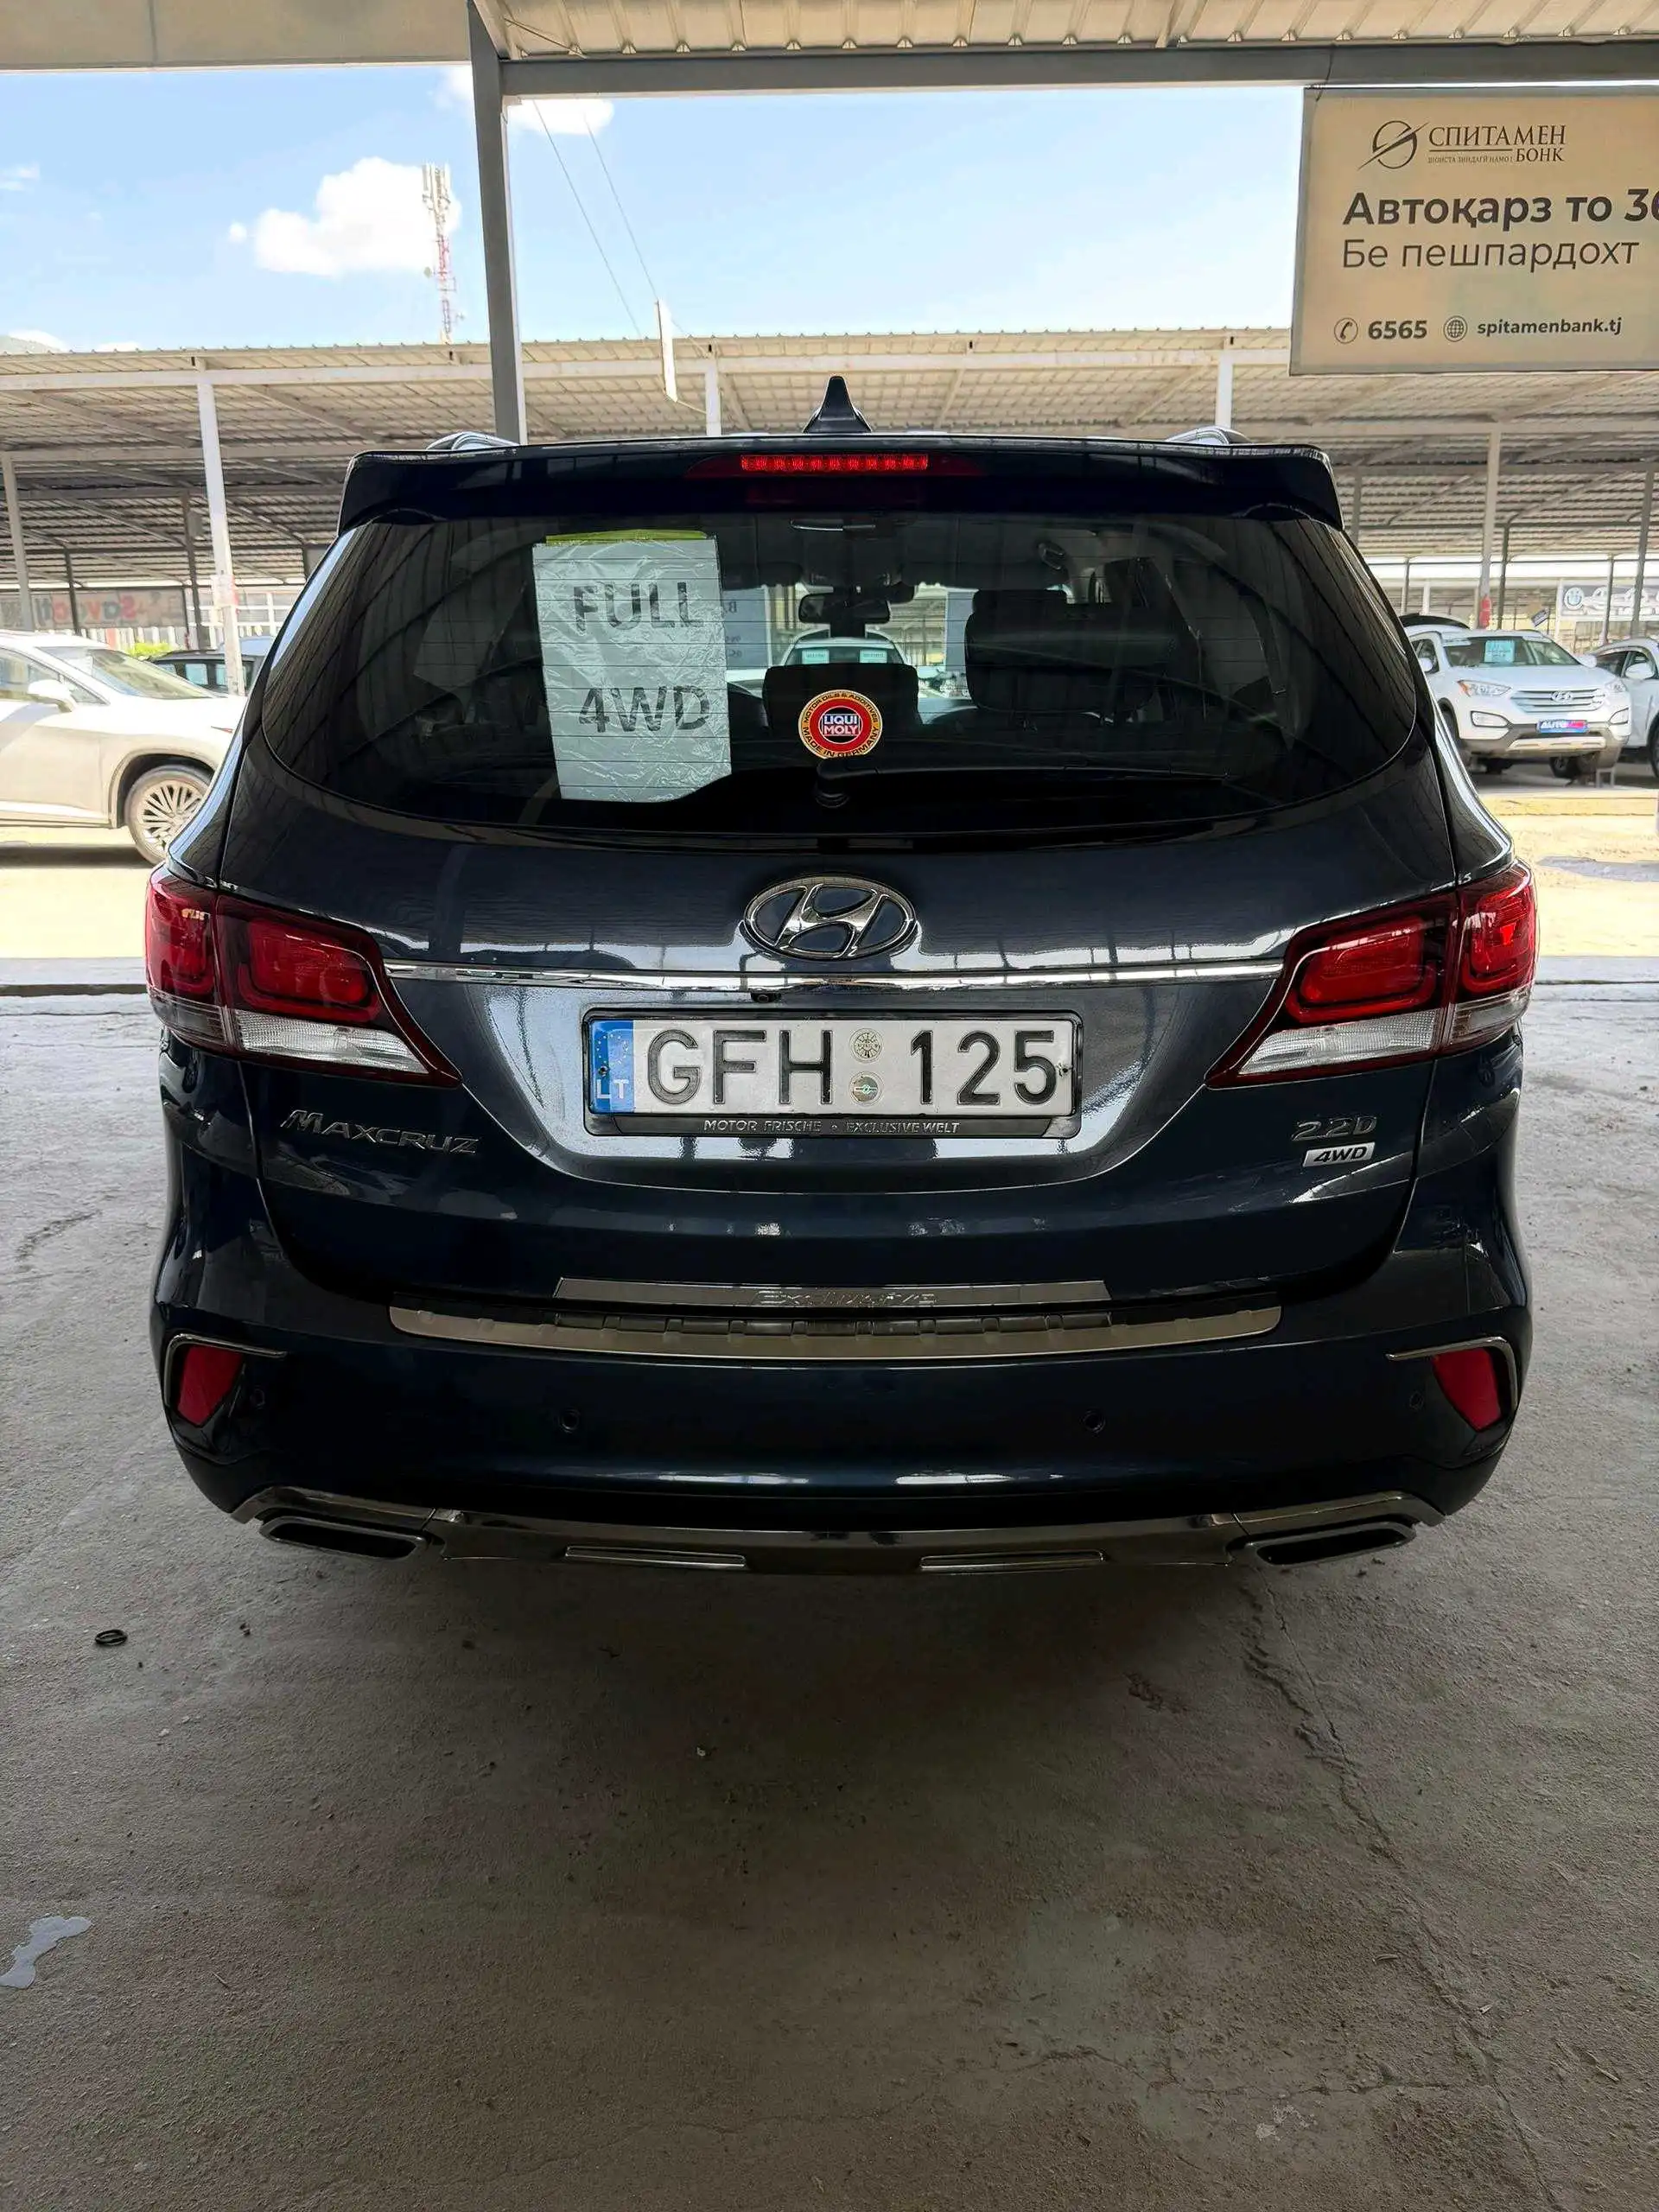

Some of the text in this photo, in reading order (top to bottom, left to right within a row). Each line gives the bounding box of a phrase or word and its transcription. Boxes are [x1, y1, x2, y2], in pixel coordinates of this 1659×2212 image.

[1428, 124, 1567, 147] СПИТАМЕН
[1516, 147, 1565, 162] БОНК
[1342, 192, 1552, 232] Автоқарз
[1566, 195, 1613, 222] то
[1343, 238, 1639, 273] Бе пешпардохт
[1368, 320, 1427, 340] 6565
[1477, 316, 1623, 337] spitamenbank.tj
[574, 582, 704, 632] FULL
[578, 684, 710, 734] 4WD
[823, 715, 858, 725] LIQUI
[823, 725, 858, 734] MOLY
[647, 1029, 1057, 1105] GFH 125
[596, 1078, 630, 1099] LT
[280, 1109, 479, 1154] MAXCRUZ
[704, 1120, 960, 1133] MOTOR FRISCHE EXCLUSIVE WELT
[1313, 1147, 1368, 1163] 4WD
